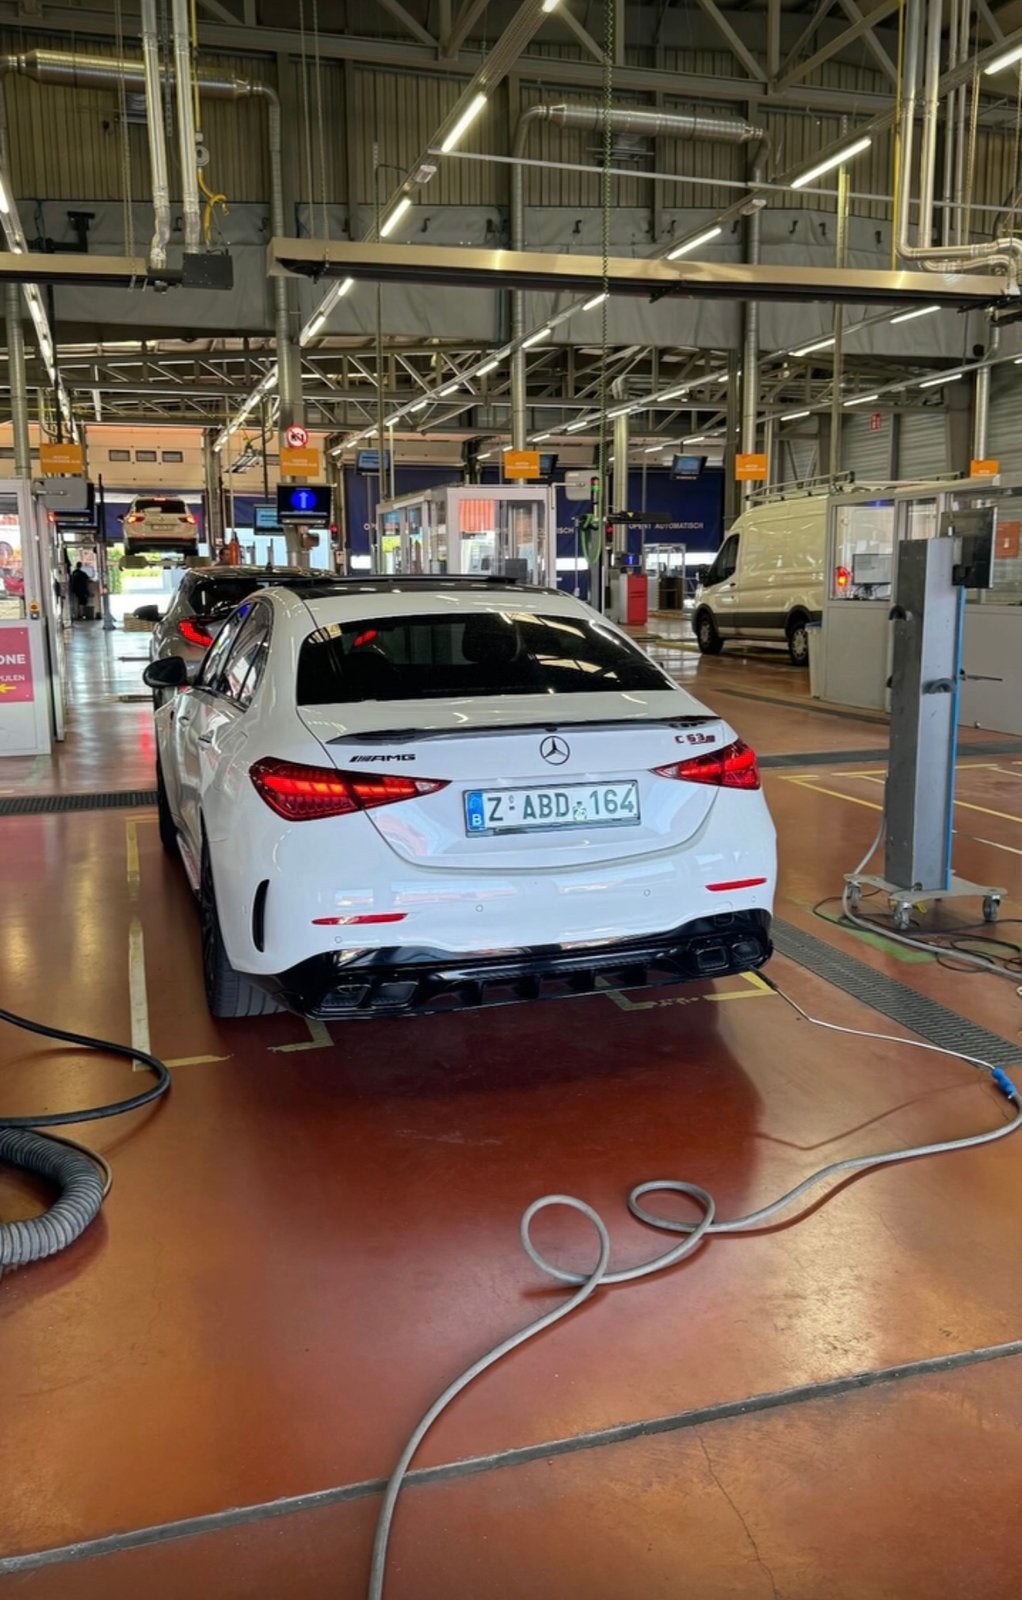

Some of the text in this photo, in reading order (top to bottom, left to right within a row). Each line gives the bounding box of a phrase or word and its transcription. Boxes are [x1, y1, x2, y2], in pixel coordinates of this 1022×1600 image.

[655, 521, 705, 530] AUTOMATISCH
[674, 735, 685, 744] C
[471, 813, 482, 827] B
